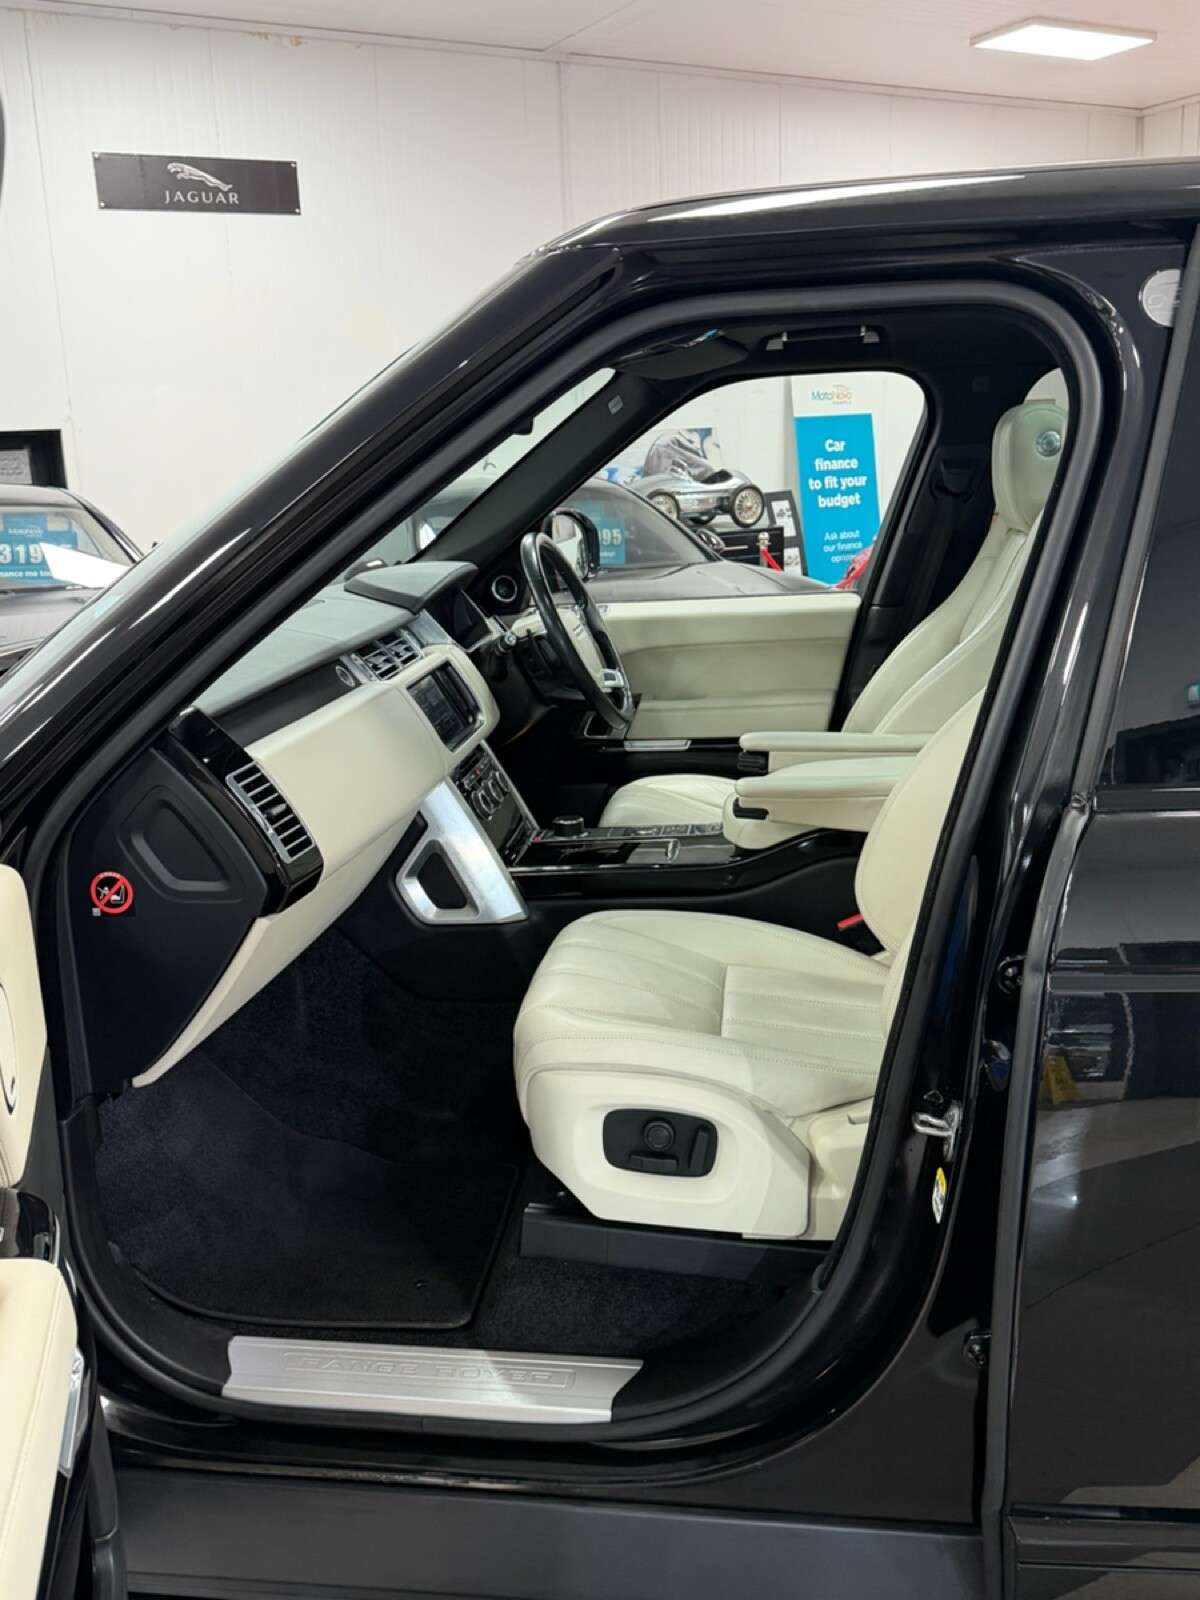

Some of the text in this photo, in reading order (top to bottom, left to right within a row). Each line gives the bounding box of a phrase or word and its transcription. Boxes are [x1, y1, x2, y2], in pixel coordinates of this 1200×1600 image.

[163, 190, 240, 205] JAGUAR
[824, 438, 845, 452] Car
[814, 457, 859, 471] finance
[808, 475, 867, 490] to fit your
[817, 492, 861, 508] budget
[599, 528, 622, 545] 95
[824, 529, 860, 541] Ask about
[823, 541, 862, 552] our finance
[301, 1357, 551, 1383] RANGE ROVER
